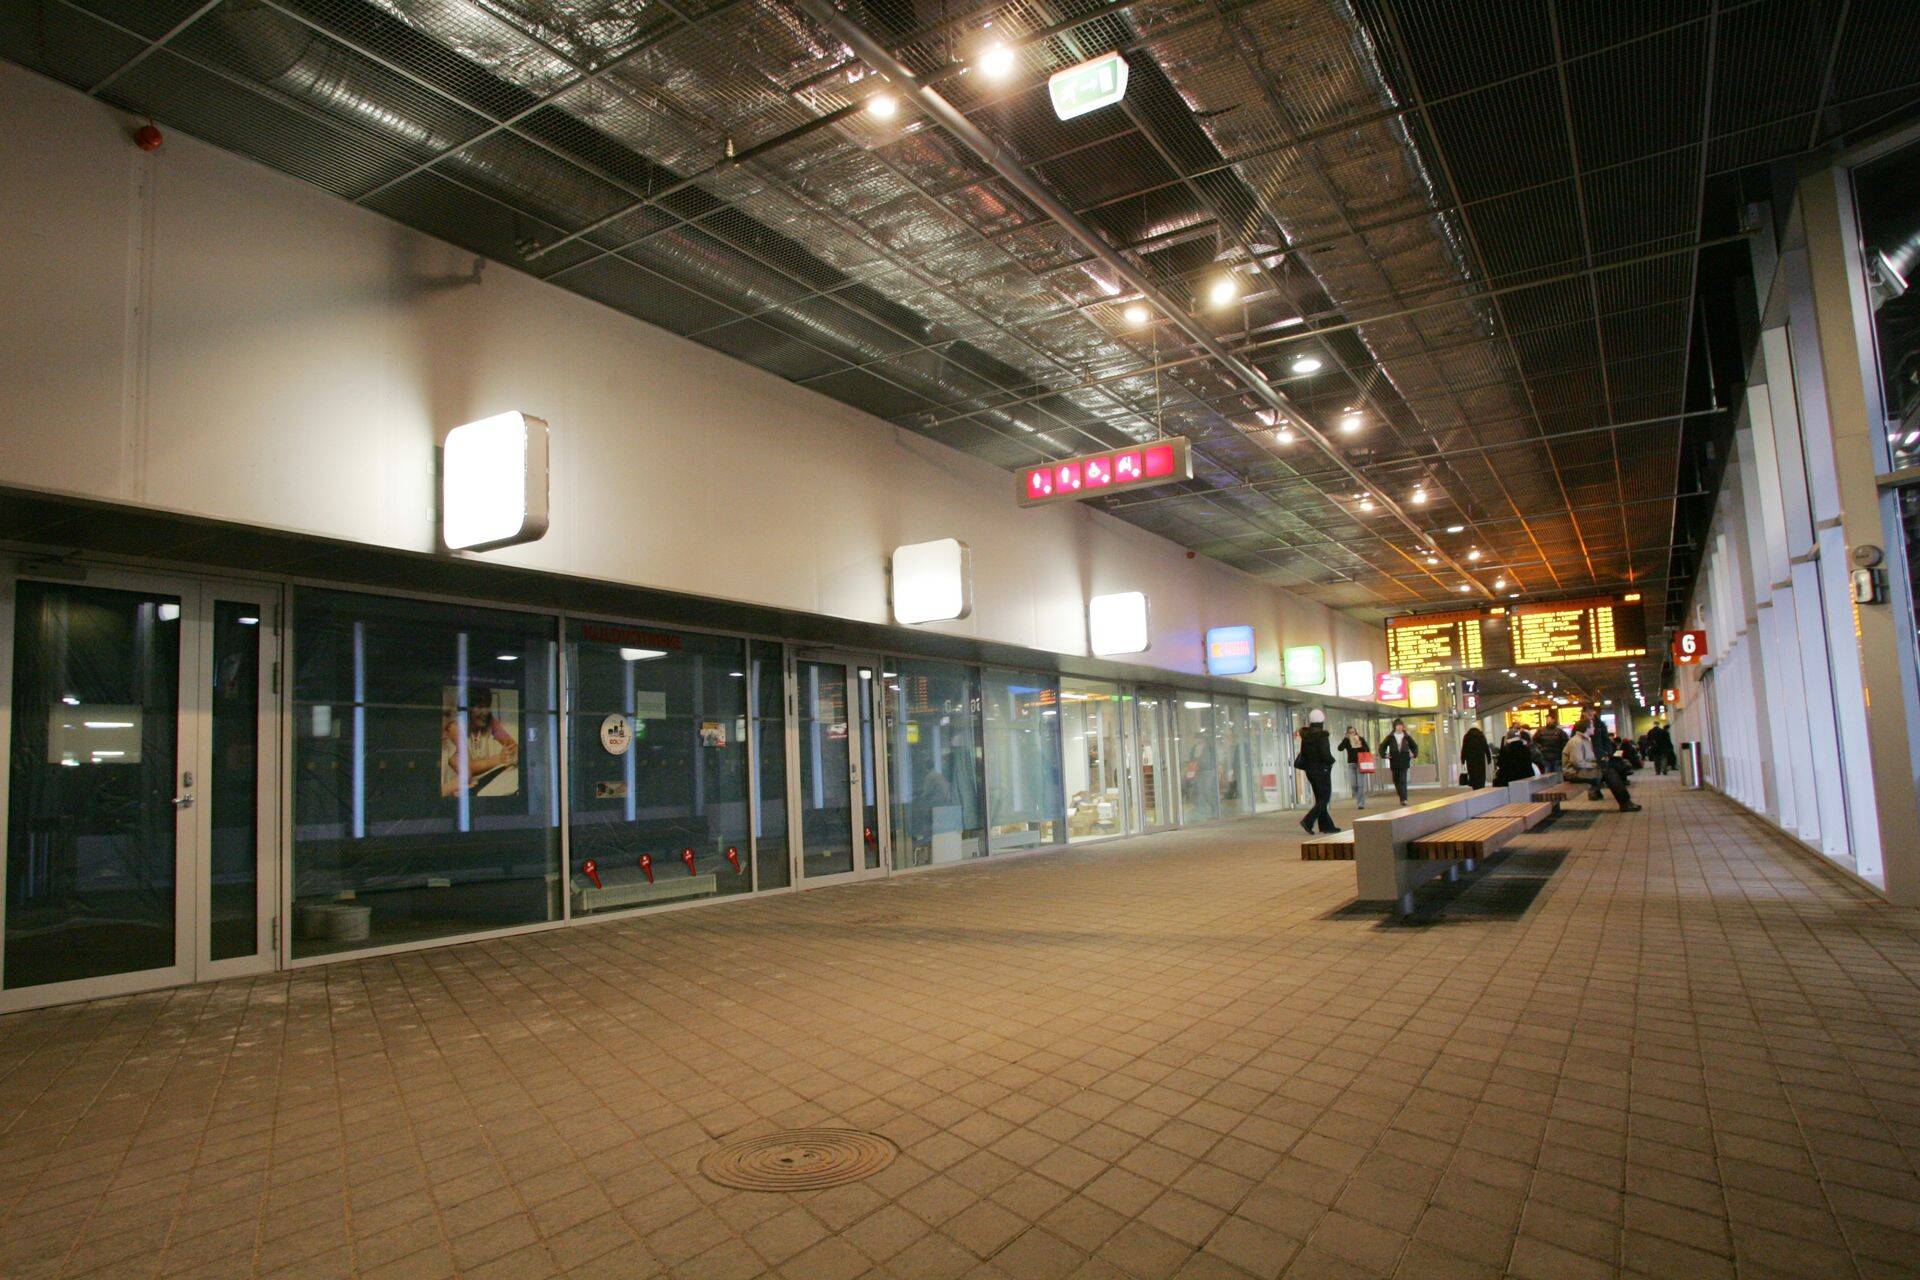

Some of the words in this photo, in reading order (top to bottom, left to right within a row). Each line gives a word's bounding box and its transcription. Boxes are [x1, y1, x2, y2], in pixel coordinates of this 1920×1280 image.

[1682, 634, 1696, 653] 6
[1466, 680, 1475, 692] 7
[1667, 690, 1675, 701] 5
